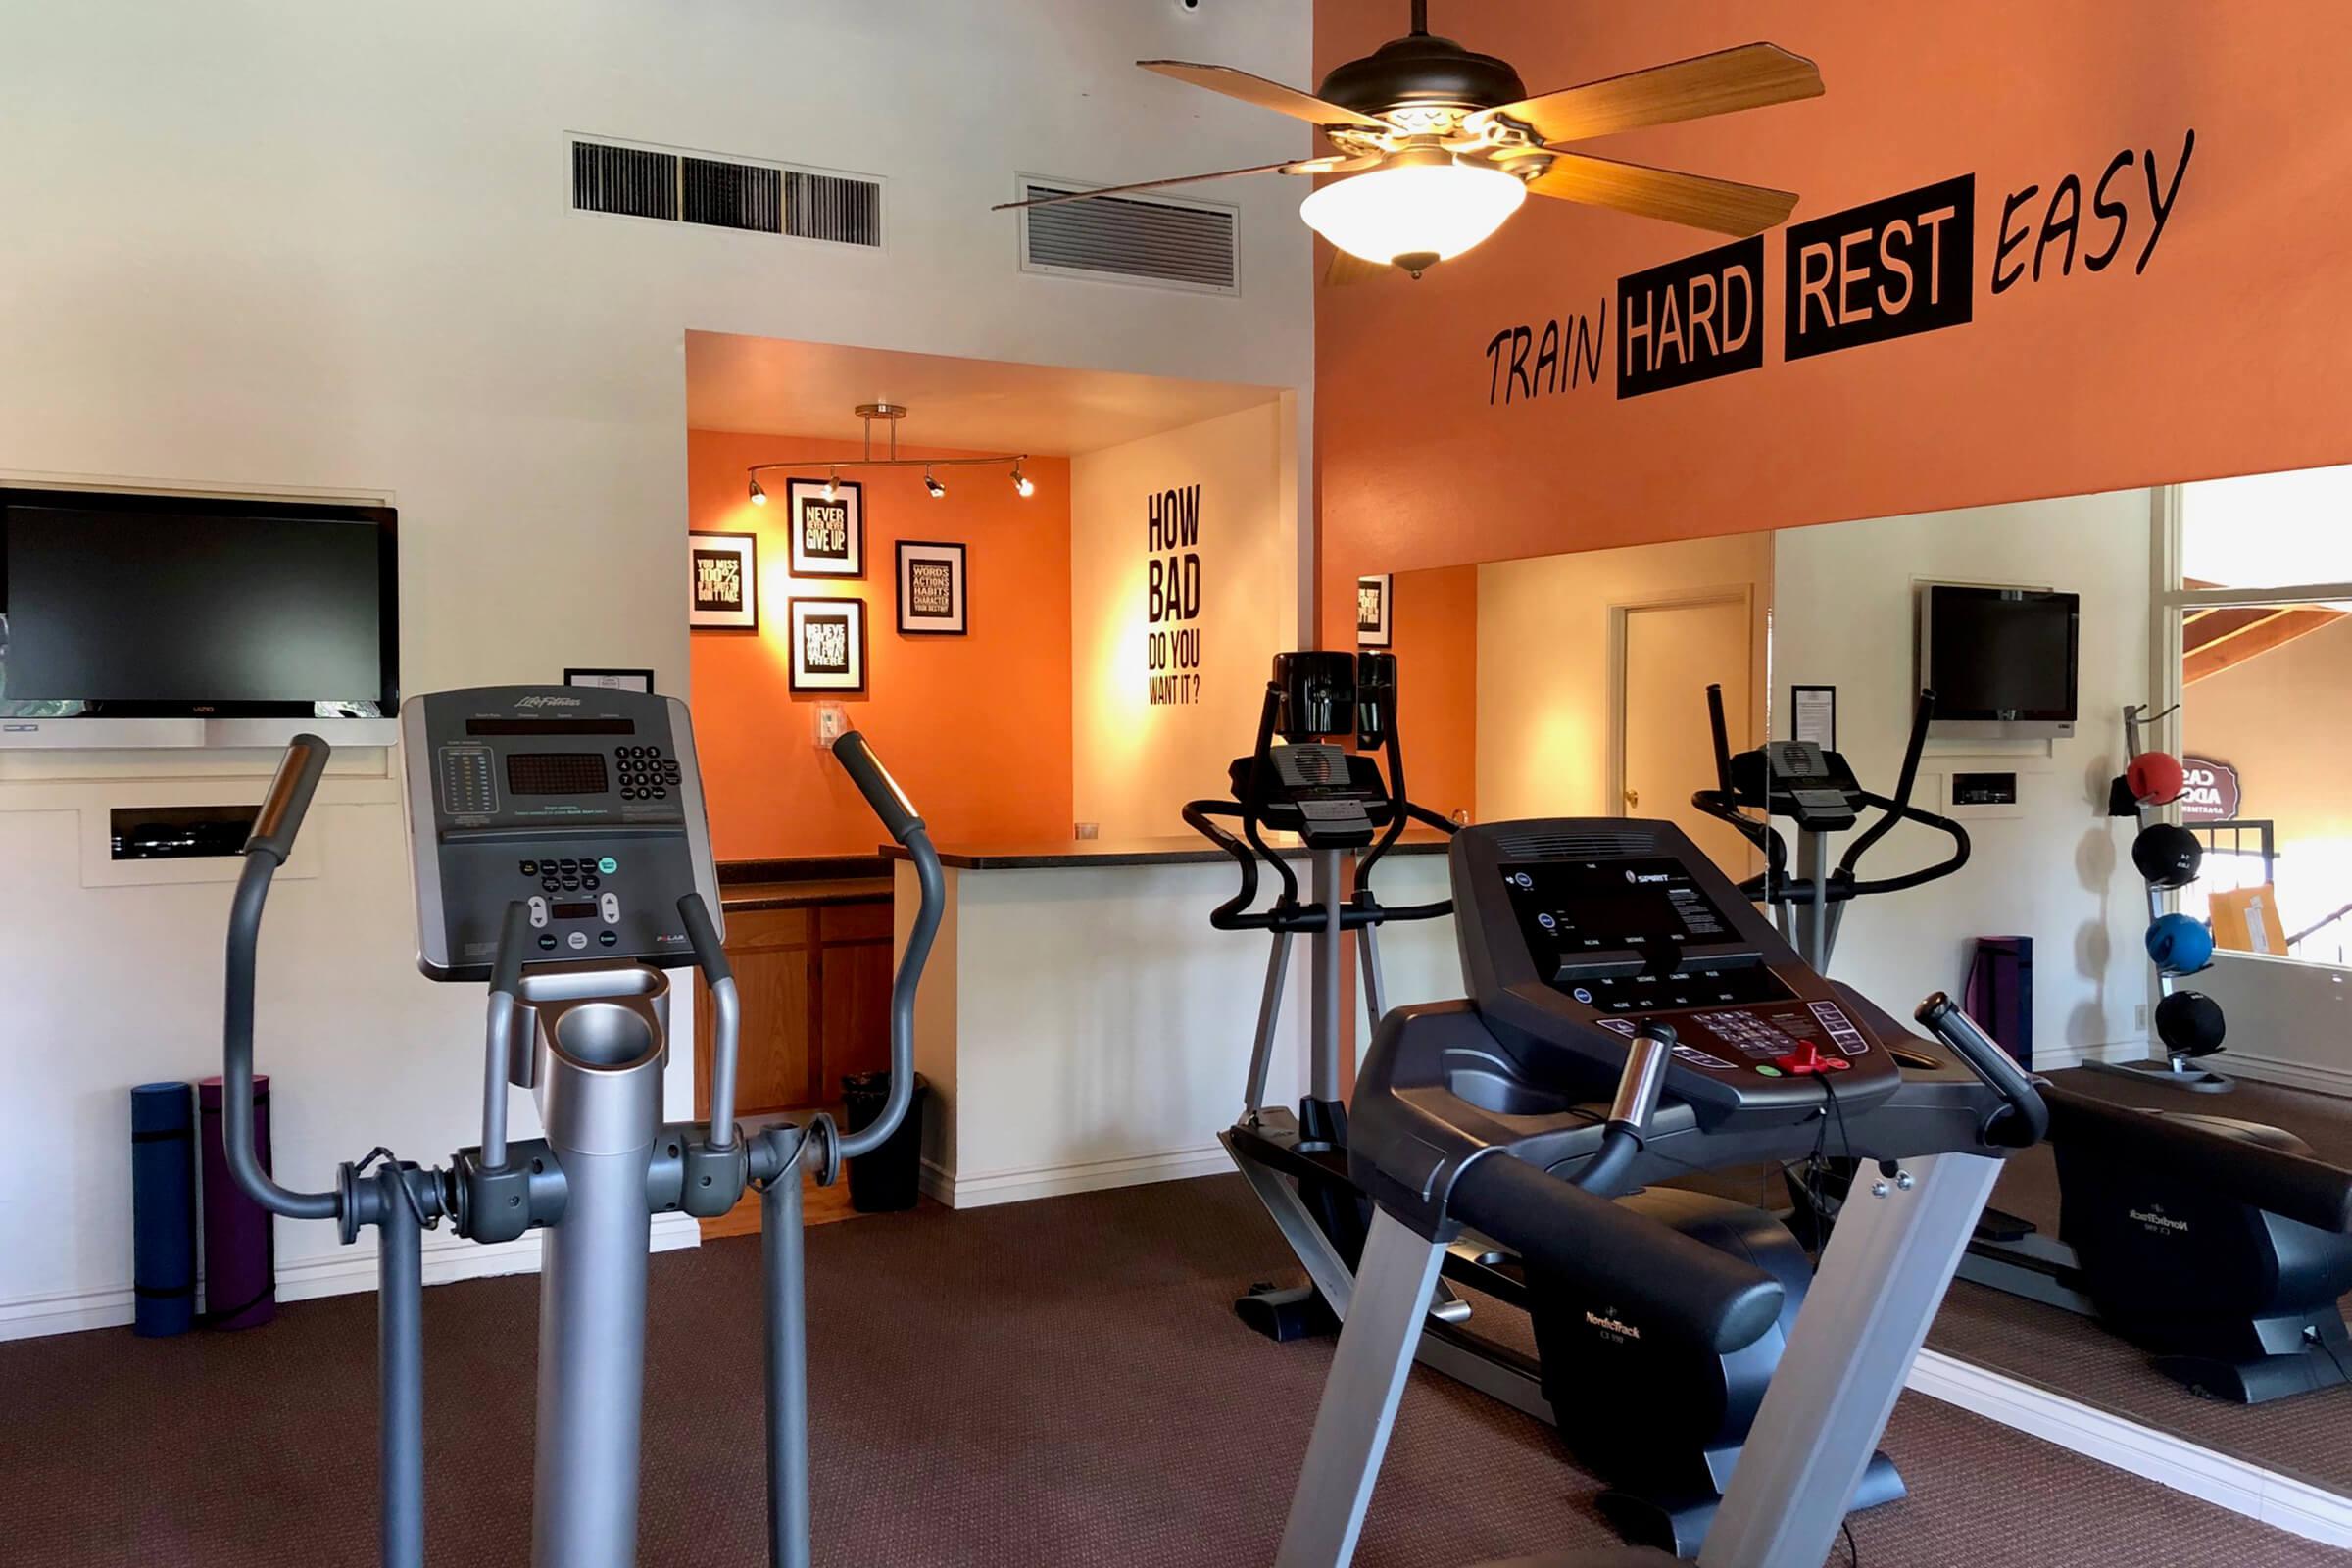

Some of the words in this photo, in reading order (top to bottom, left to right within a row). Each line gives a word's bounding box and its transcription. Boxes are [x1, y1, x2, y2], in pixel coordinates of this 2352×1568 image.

[1486, 297, 1607, 405] TRAIN
[1624, 263, 1753, 377] HARD
[1797, 204, 1957, 335] REST
[1991, 128, 2195, 295] EASY
[806, 506, 845, 522] NEVER
[1148, 484, 1200, 552] HOW
[806, 529, 830, 551] GIVE
[830, 530, 846, 551] UP
[697, 559, 714, 569] YOU
[715, 559, 739, 570] MISS
[912, 567, 950, 577] WORDS
[698, 564, 740, 584] 100%
[912, 577, 950, 587] ACTIONS
[913, 587, 950, 596] HABITS
[1149, 553, 1200, 624] BAD
[806, 623, 846, 636] BELIEVE
[1149, 632, 1166, 670] DO
[1170, 628, 1200, 668] YOU
[807, 658, 847, 666] THERE
[1149, 675, 1179, 705] WANT
[1180, 674, 1191, 705] IT
[1193, 673, 1200, 704] ?
[1637, 874, 1669, 883] SPIRIT
[1586, 1311, 1640, 1339] NordicTrack
